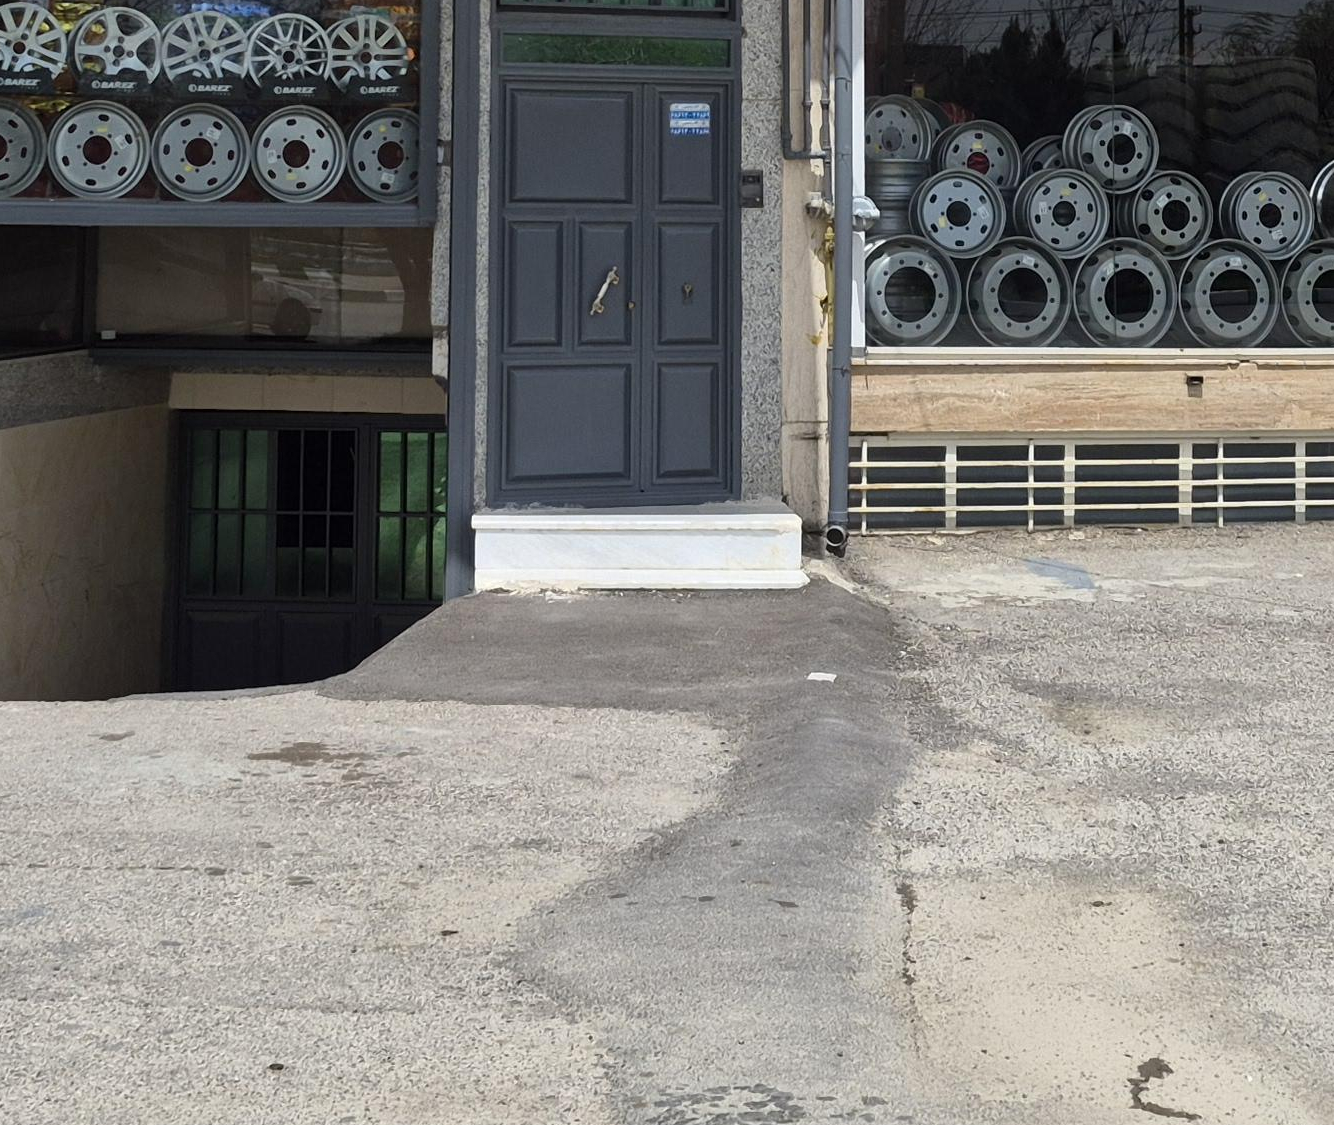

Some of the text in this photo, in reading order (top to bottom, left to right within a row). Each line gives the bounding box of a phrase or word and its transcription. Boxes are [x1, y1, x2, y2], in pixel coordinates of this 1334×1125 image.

[4, 78, 41, 86] BAREZ
[100, 81, 138, 89] BAREZ
[197, 84, 234, 92] BAREZ
[282, 86, 317, 94] BAREZ
[368, 85, 401, 94] BAREZ
